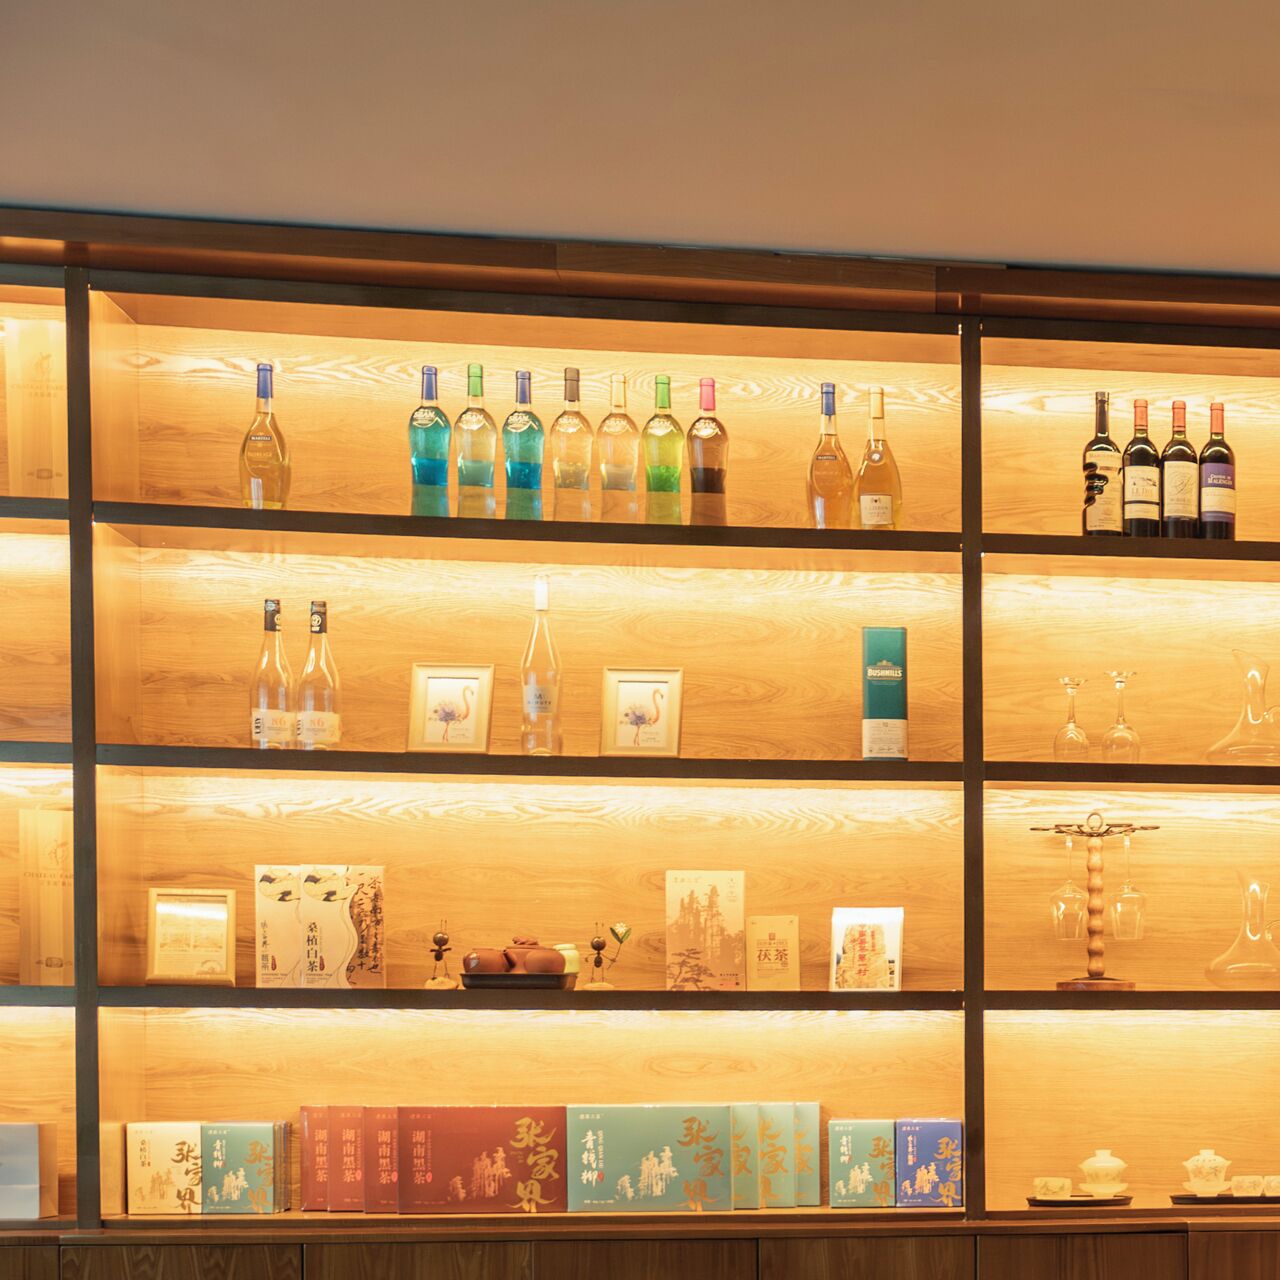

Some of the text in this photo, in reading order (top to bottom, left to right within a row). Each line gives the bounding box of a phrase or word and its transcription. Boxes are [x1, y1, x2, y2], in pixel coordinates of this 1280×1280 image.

[867, 668, 902, 677] BUSHMILLS
[307, 922, 318, 973] 桑植白茶
[170, 1140, 202, 1213] 张家界
[314, 1129, 328, 1182] 湖南黑茶
[342, 1129, 355, 1183] 湖南黑茶
[378, 1130, 391, 1184] 湖南黑茶
[412, 1130, 425, 1185] 湖南黑茶
[506, 1117, 561, 1213] 张家界
[580, 1129, 598, 1188] 青钱柳
[675, 1116, 725, 1211] 张家界
[930, 1136, 961, 1206] 张家界
